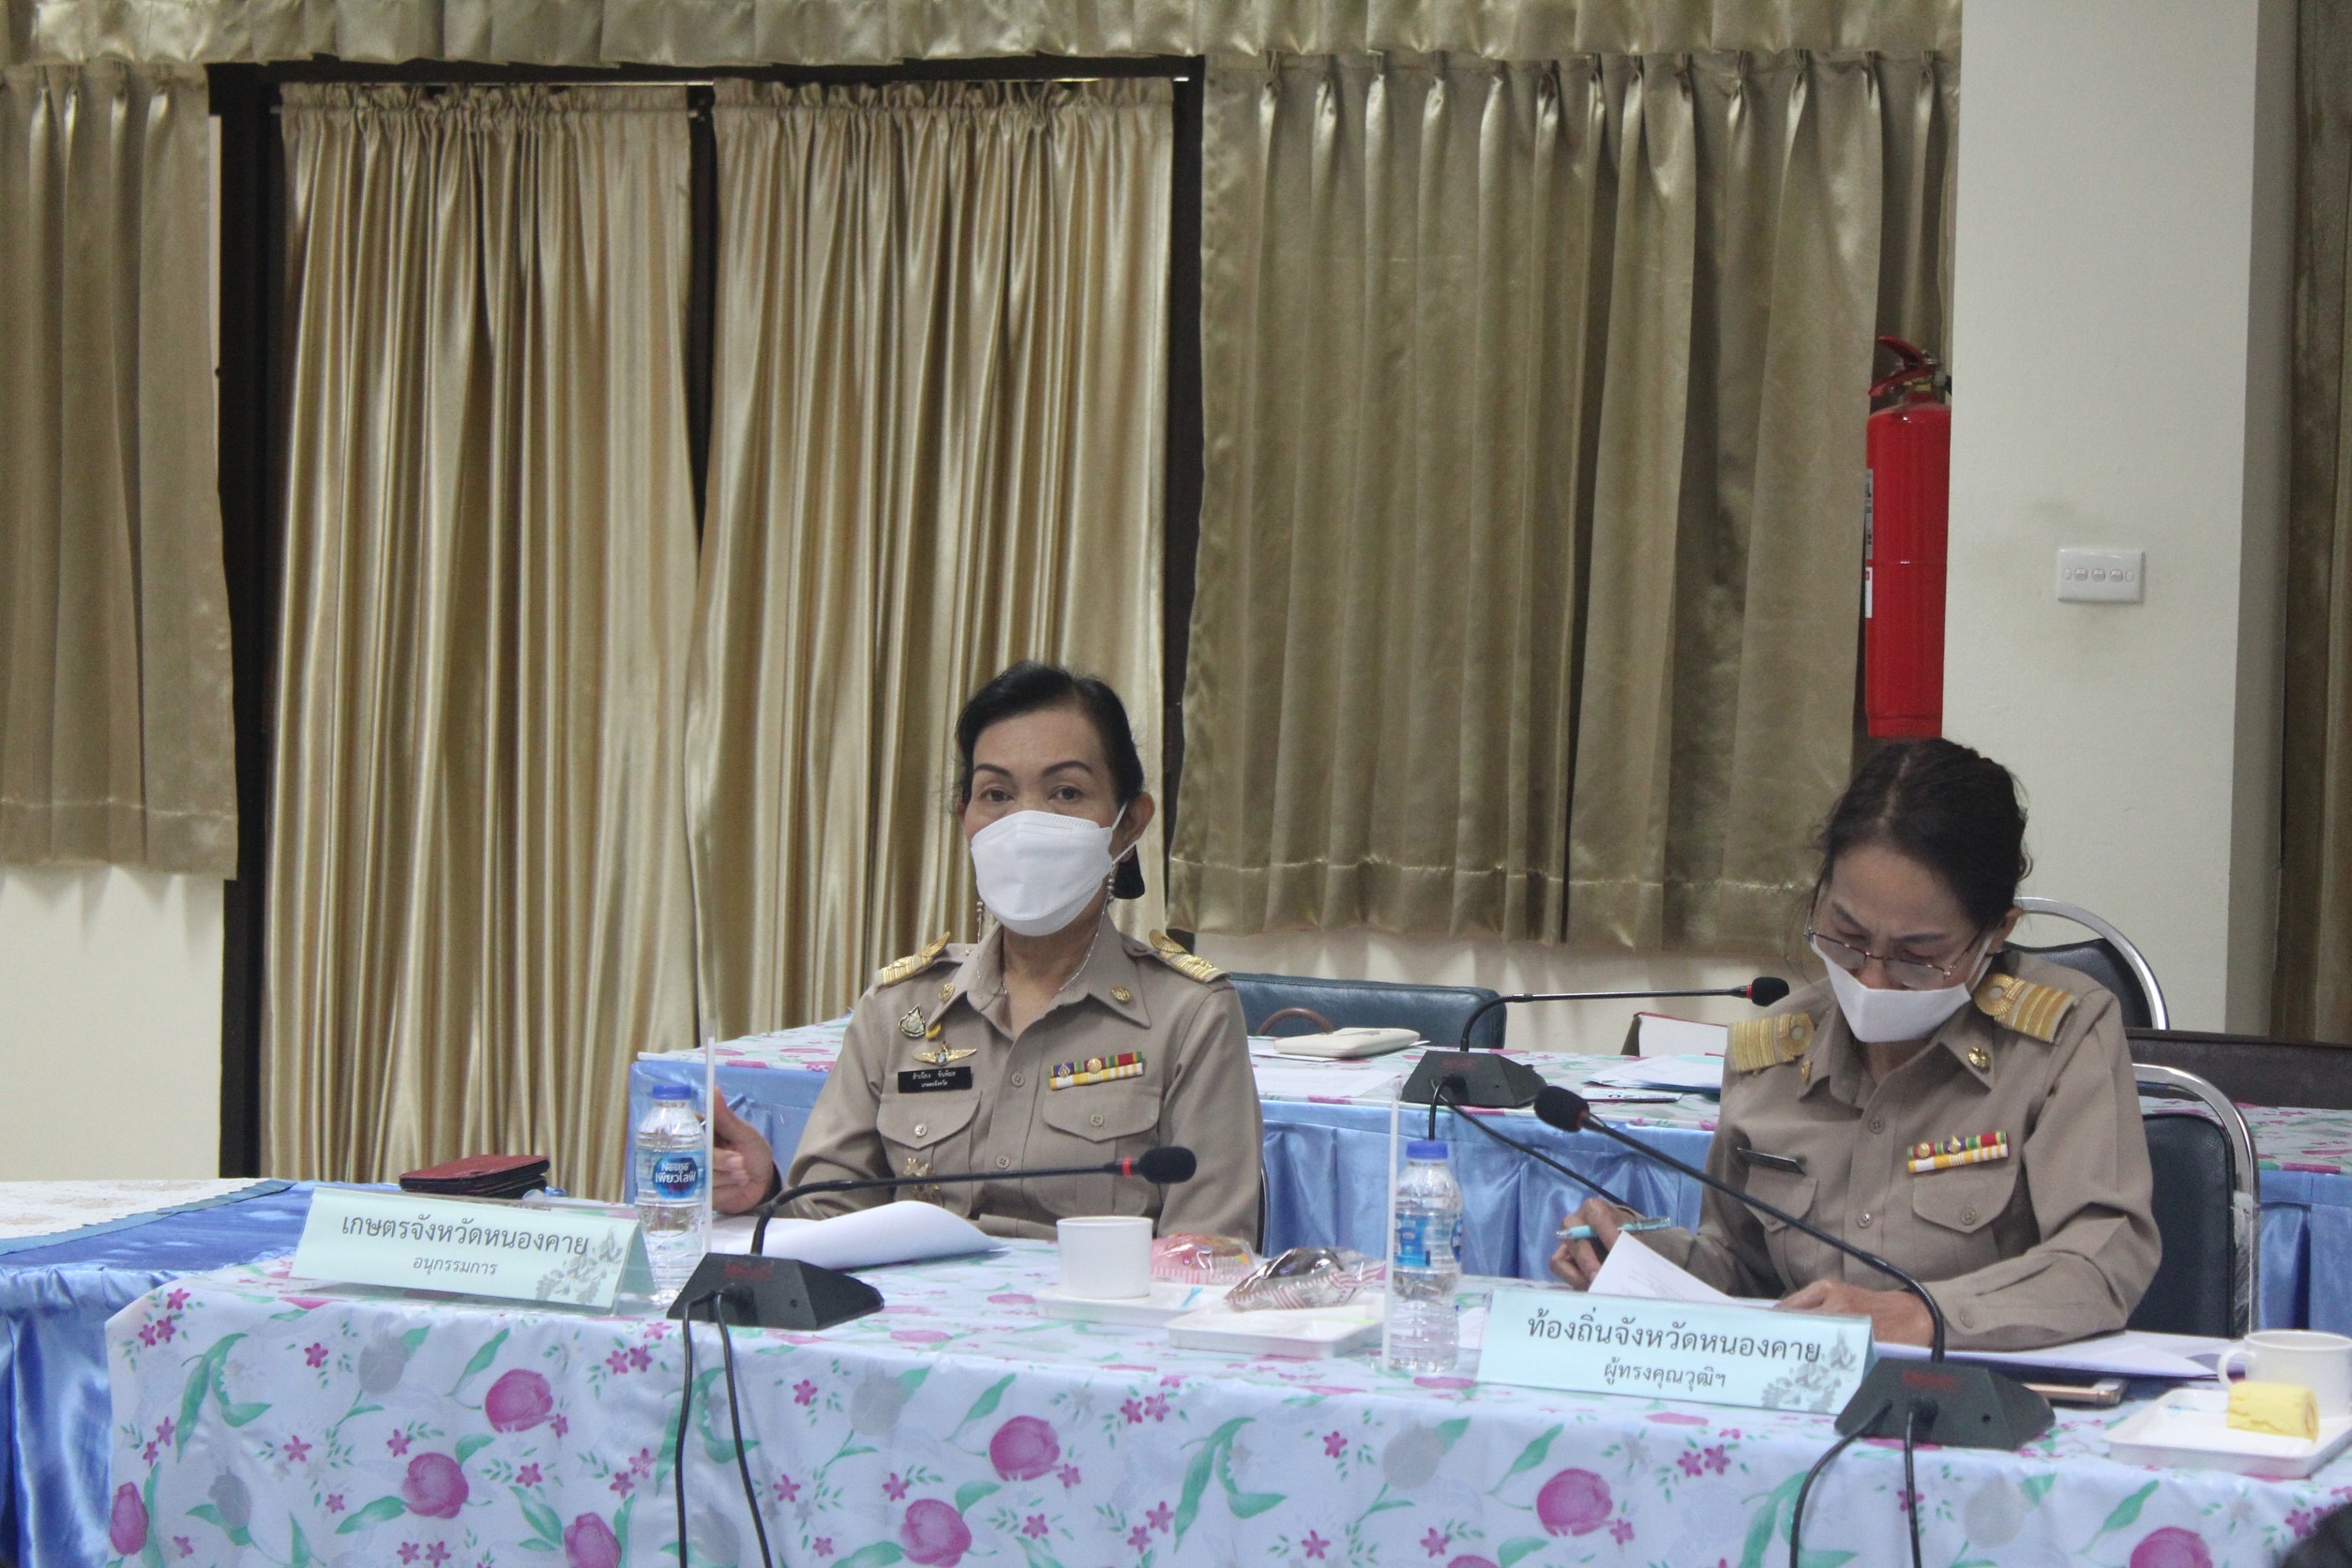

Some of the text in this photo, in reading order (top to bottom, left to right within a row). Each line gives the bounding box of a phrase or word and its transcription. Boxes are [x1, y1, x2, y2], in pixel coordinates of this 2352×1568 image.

[341, 1214, 590, 1256] เกษตรจังหวัดหนองคาย
[412, 1257, 499, 1276] อนุกรรมการ
[1527, 1306, 1821, 1364] ท้องถิ่นจังหวัดหนองคาย
[1604, 1356, 1726, 1393] ผู้ทรงคุณวุฒิฯ
